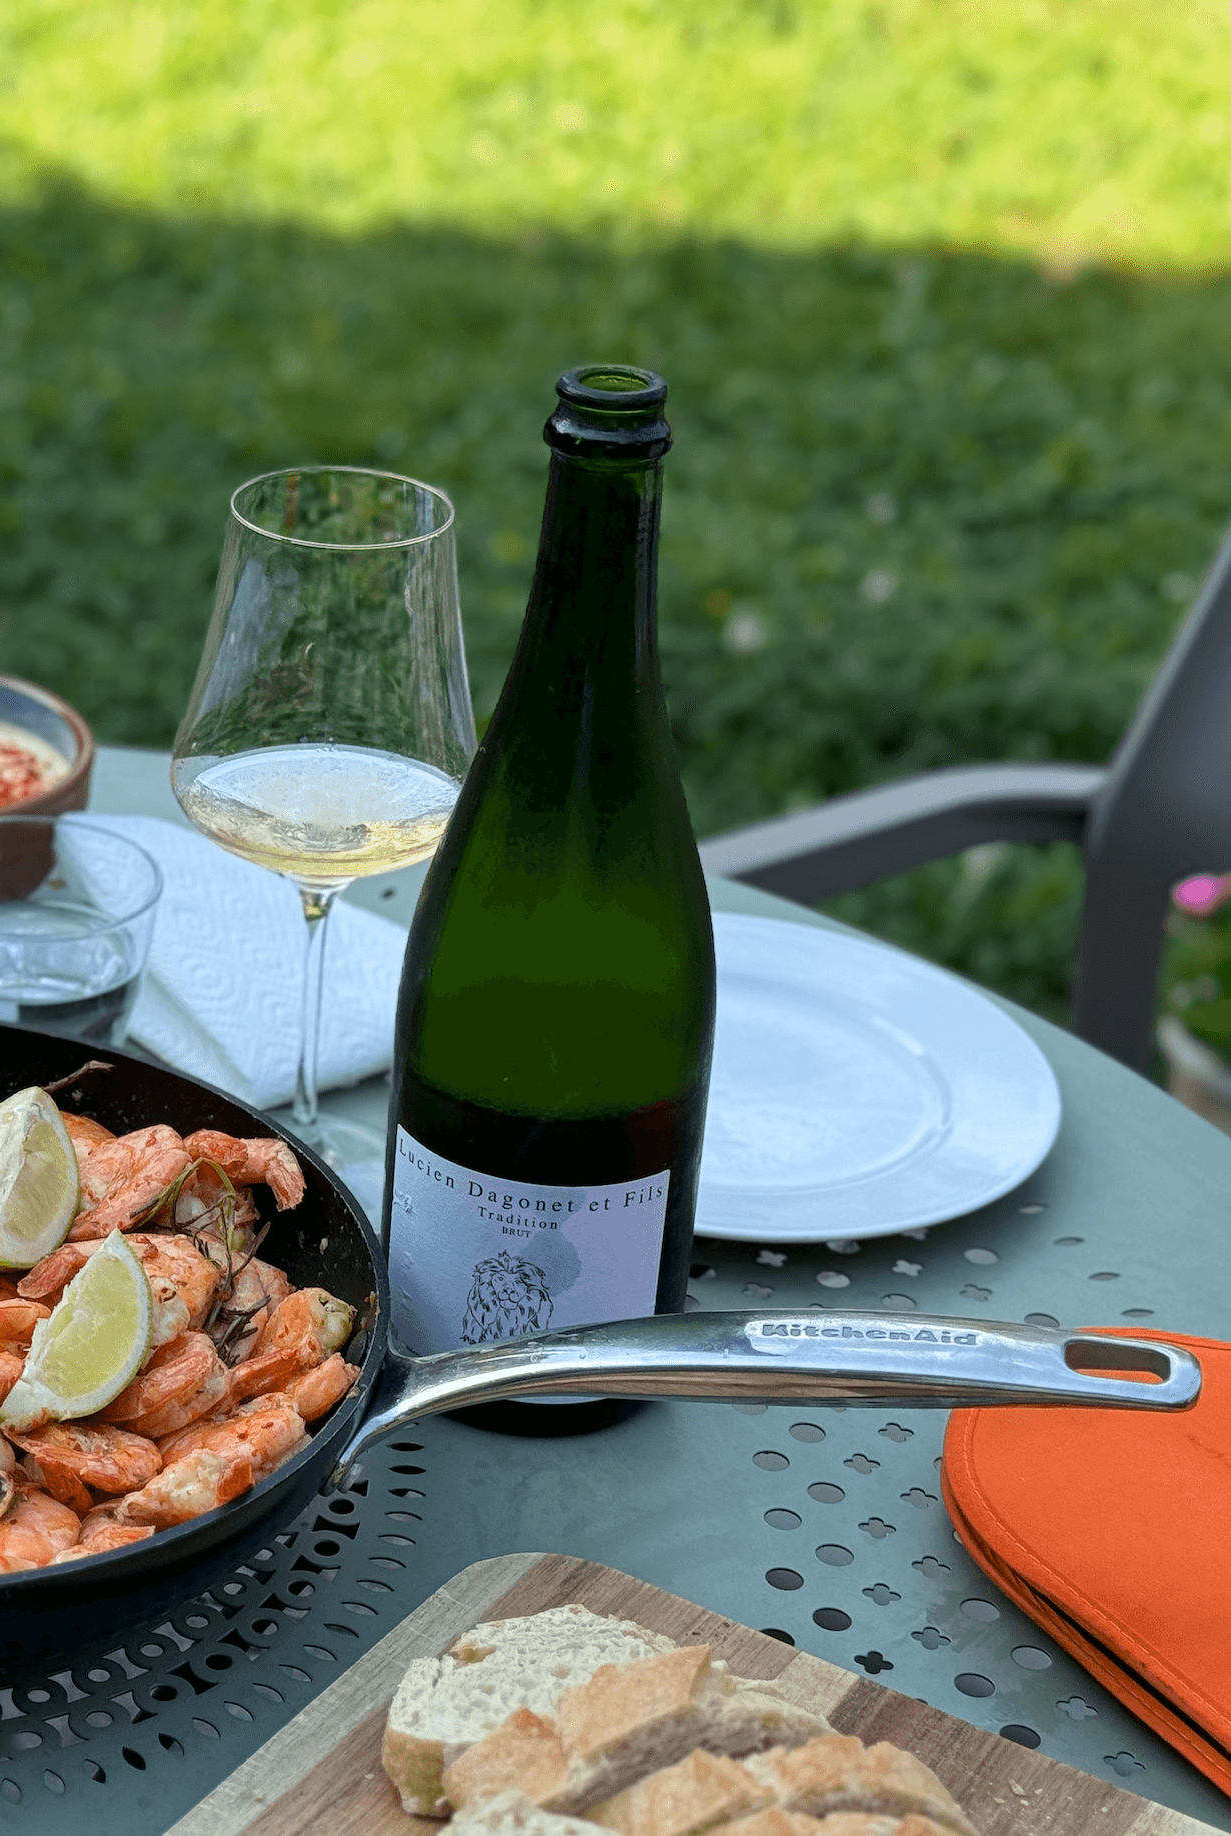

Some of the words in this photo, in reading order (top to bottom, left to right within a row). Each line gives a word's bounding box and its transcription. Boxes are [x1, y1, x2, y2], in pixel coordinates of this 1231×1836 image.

[399, 1138, 455, 1189] Lucien
[469, 1180, 574, 1213] Dagonet
[589, 1198, 611, 1212] et
[623, 1185, 663, 1209] Fils
[478, 1206, 558, 1230] Tradition
[502, 1227, 532, 1239] BRUT
[761, 1324, 978, 1346] KitchenAid
